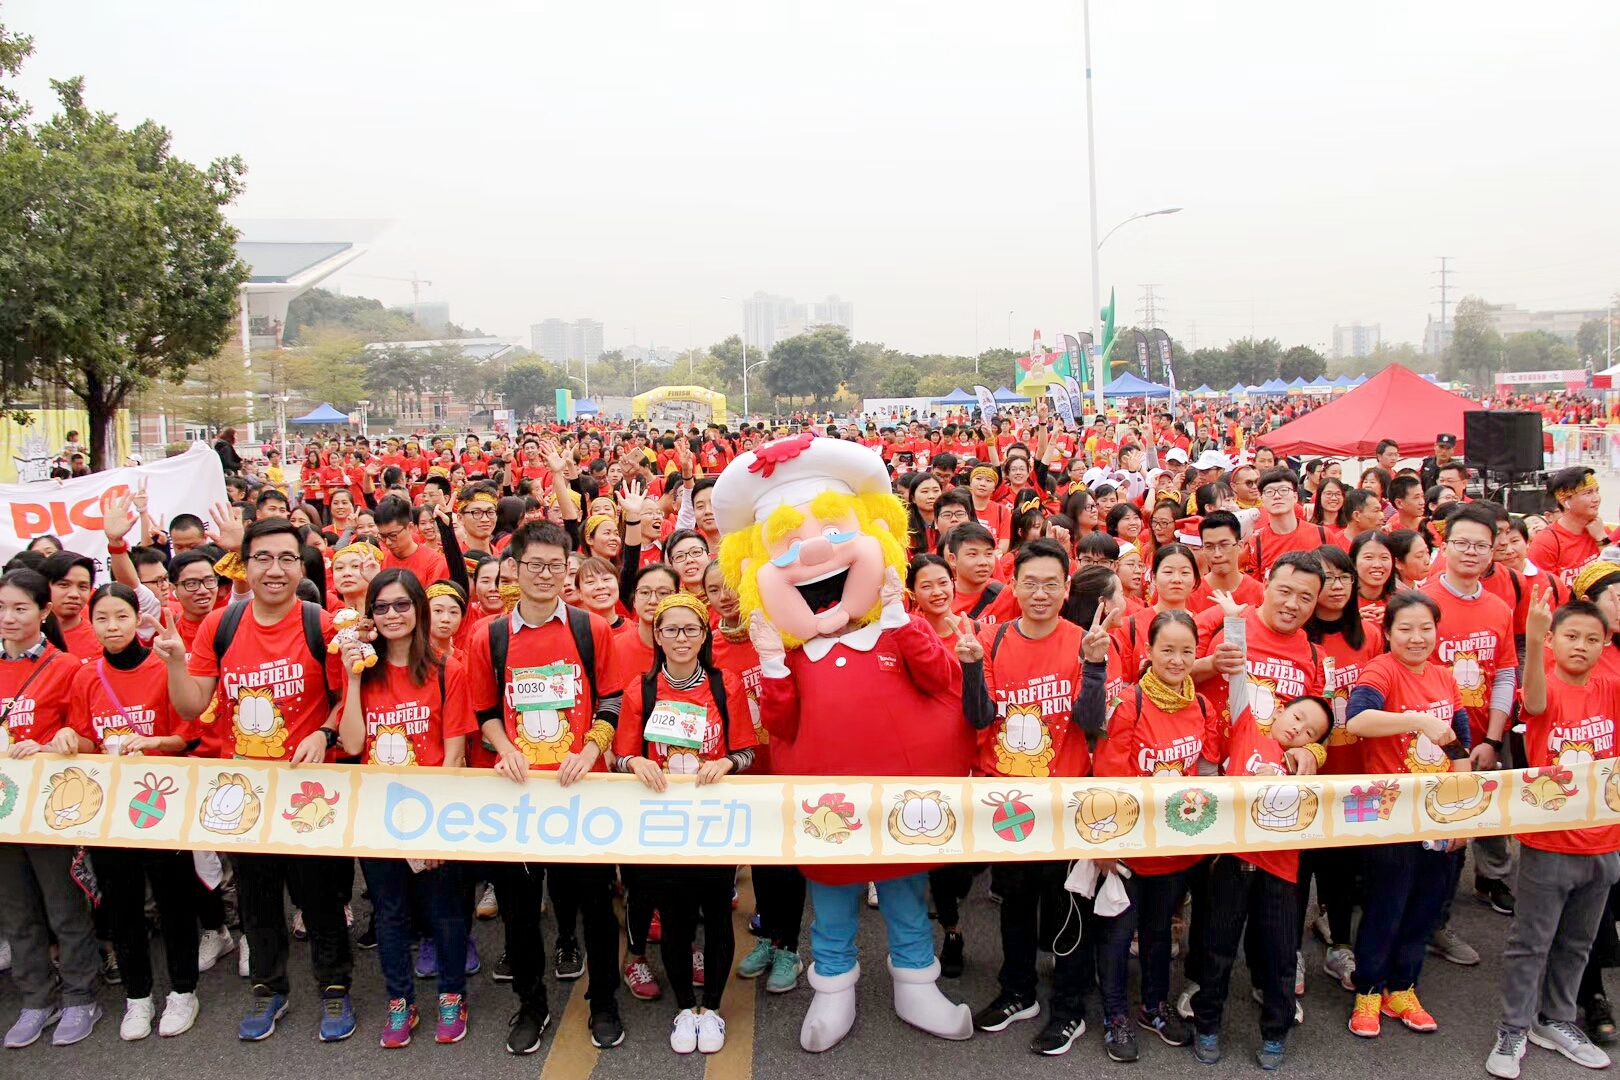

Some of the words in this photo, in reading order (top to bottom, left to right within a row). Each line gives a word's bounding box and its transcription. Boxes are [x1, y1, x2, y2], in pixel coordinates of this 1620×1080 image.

[223, 663, 304, 700] GARFIELD
[1245, 660, 1305, 683] ARFIELD
[273, 679, 305, 699] RUN
[517, 682, 546, 694] 0030
[1276, 678, 1305, 697] RUN
[1041, 695, 1072, 716] RUN
[9, 712, 35, 728] RUN
[366, 706, 431, 737] GARFIELD
[405, 720, 429, 736] RUN
[651, 713, 676, 727] 0128
[1547, 719, 1614, 753] GARFIELD
[638, 798, 752, 848] 百动
